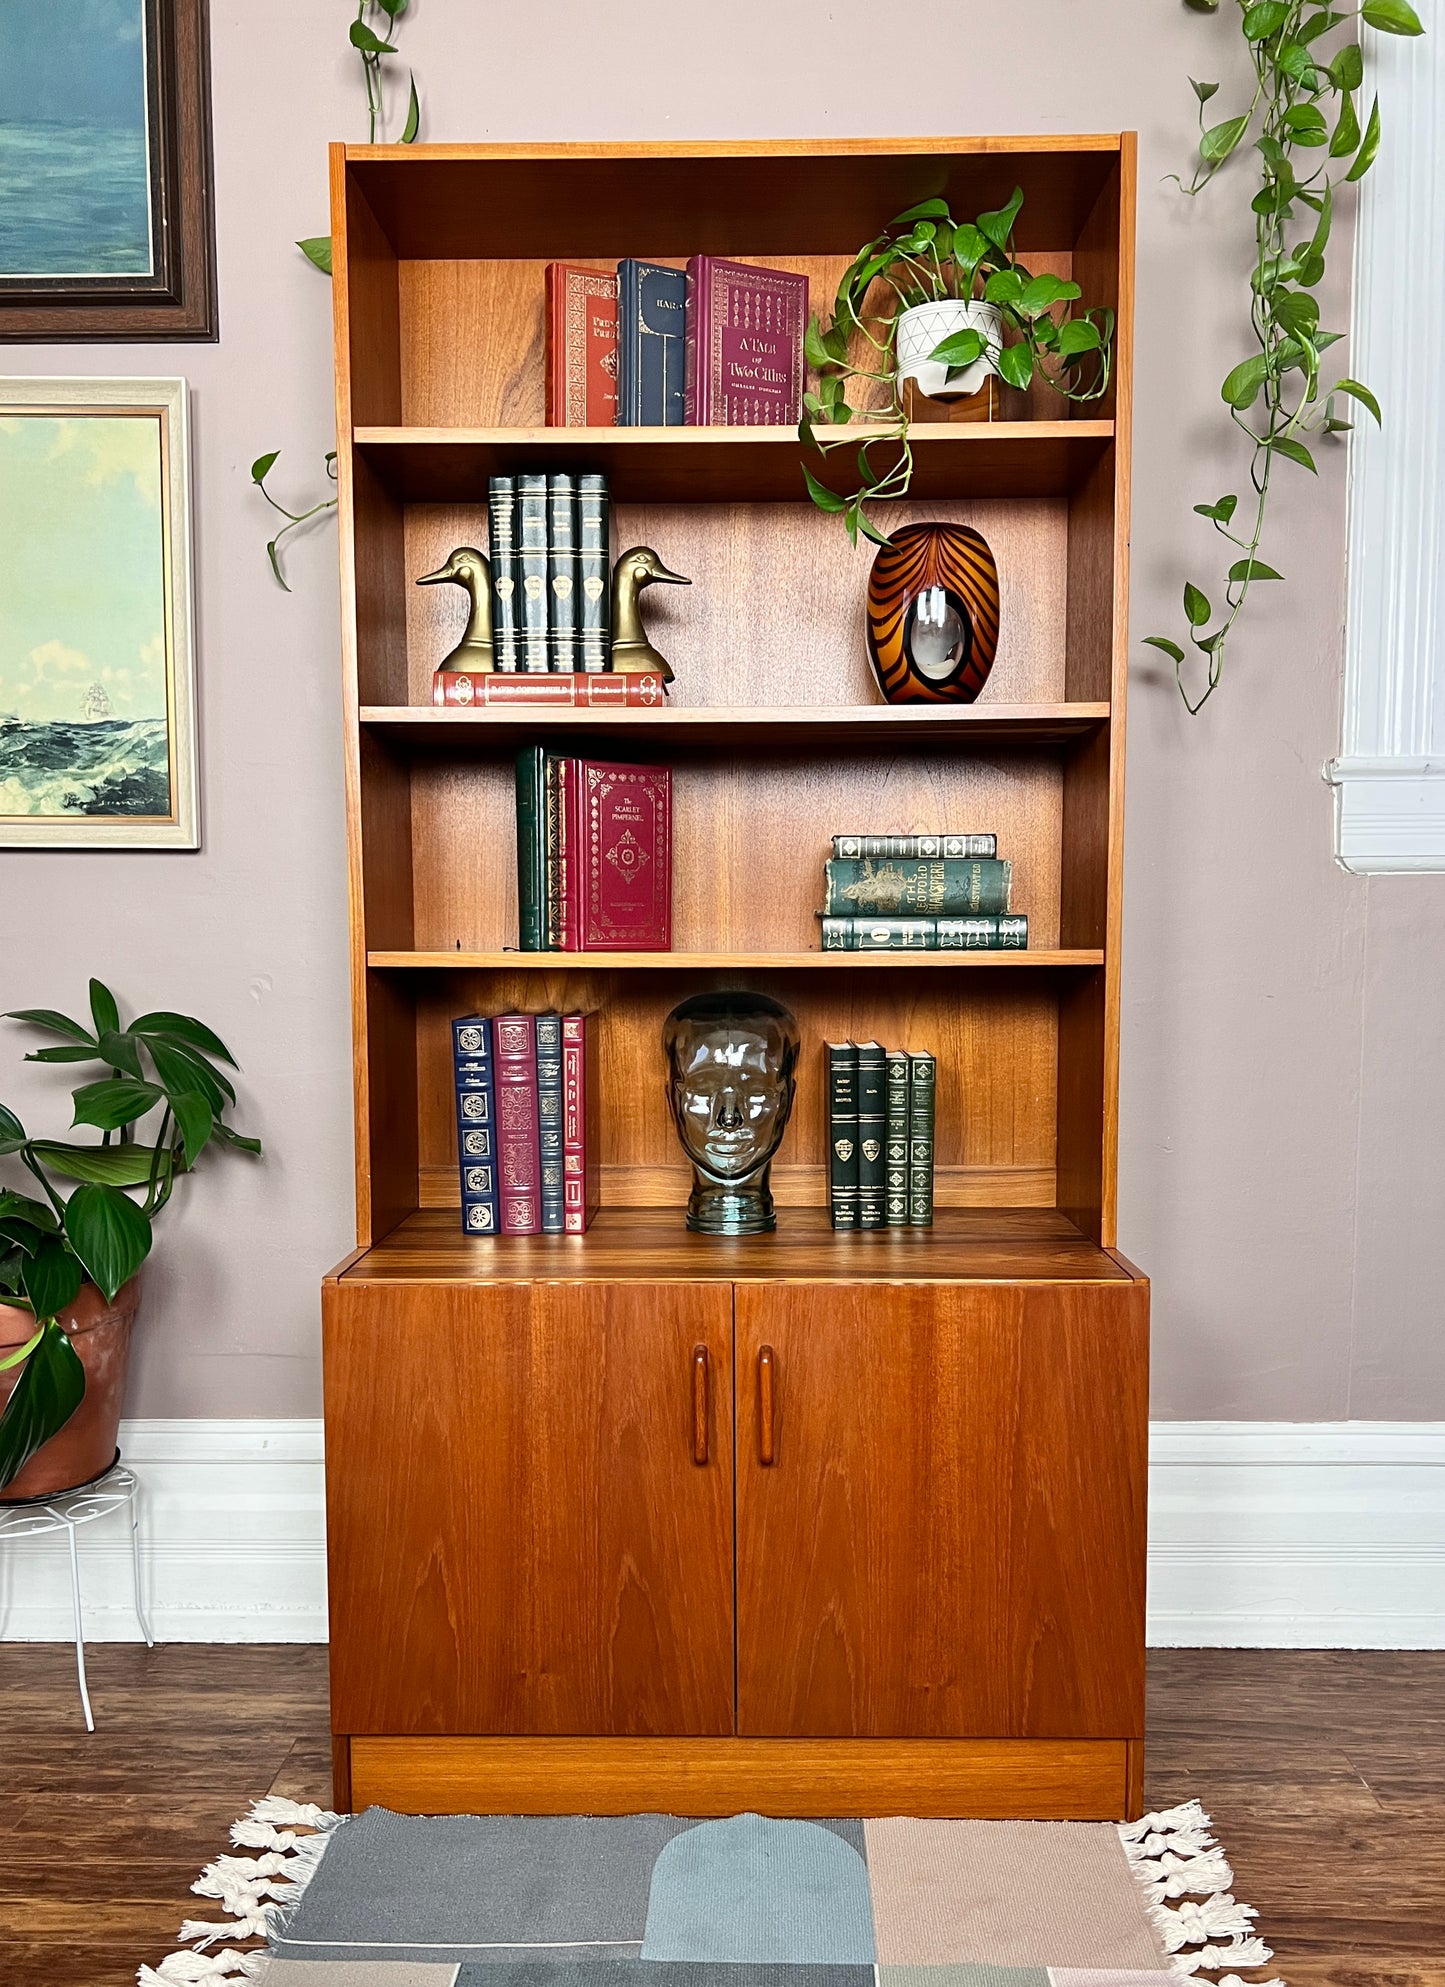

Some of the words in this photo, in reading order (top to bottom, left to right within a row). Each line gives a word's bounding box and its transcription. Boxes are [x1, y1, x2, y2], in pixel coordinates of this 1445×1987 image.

[739, 338, 749, 351] A
[749, 337, 777, 355] TALE
[611, 813, 644, 822] PIMPERNEL
[614, 805, 640, 813] SCARLET
[906, 873, 918, 905] THE
[913, 865, 929, 914] LEOPOLD
